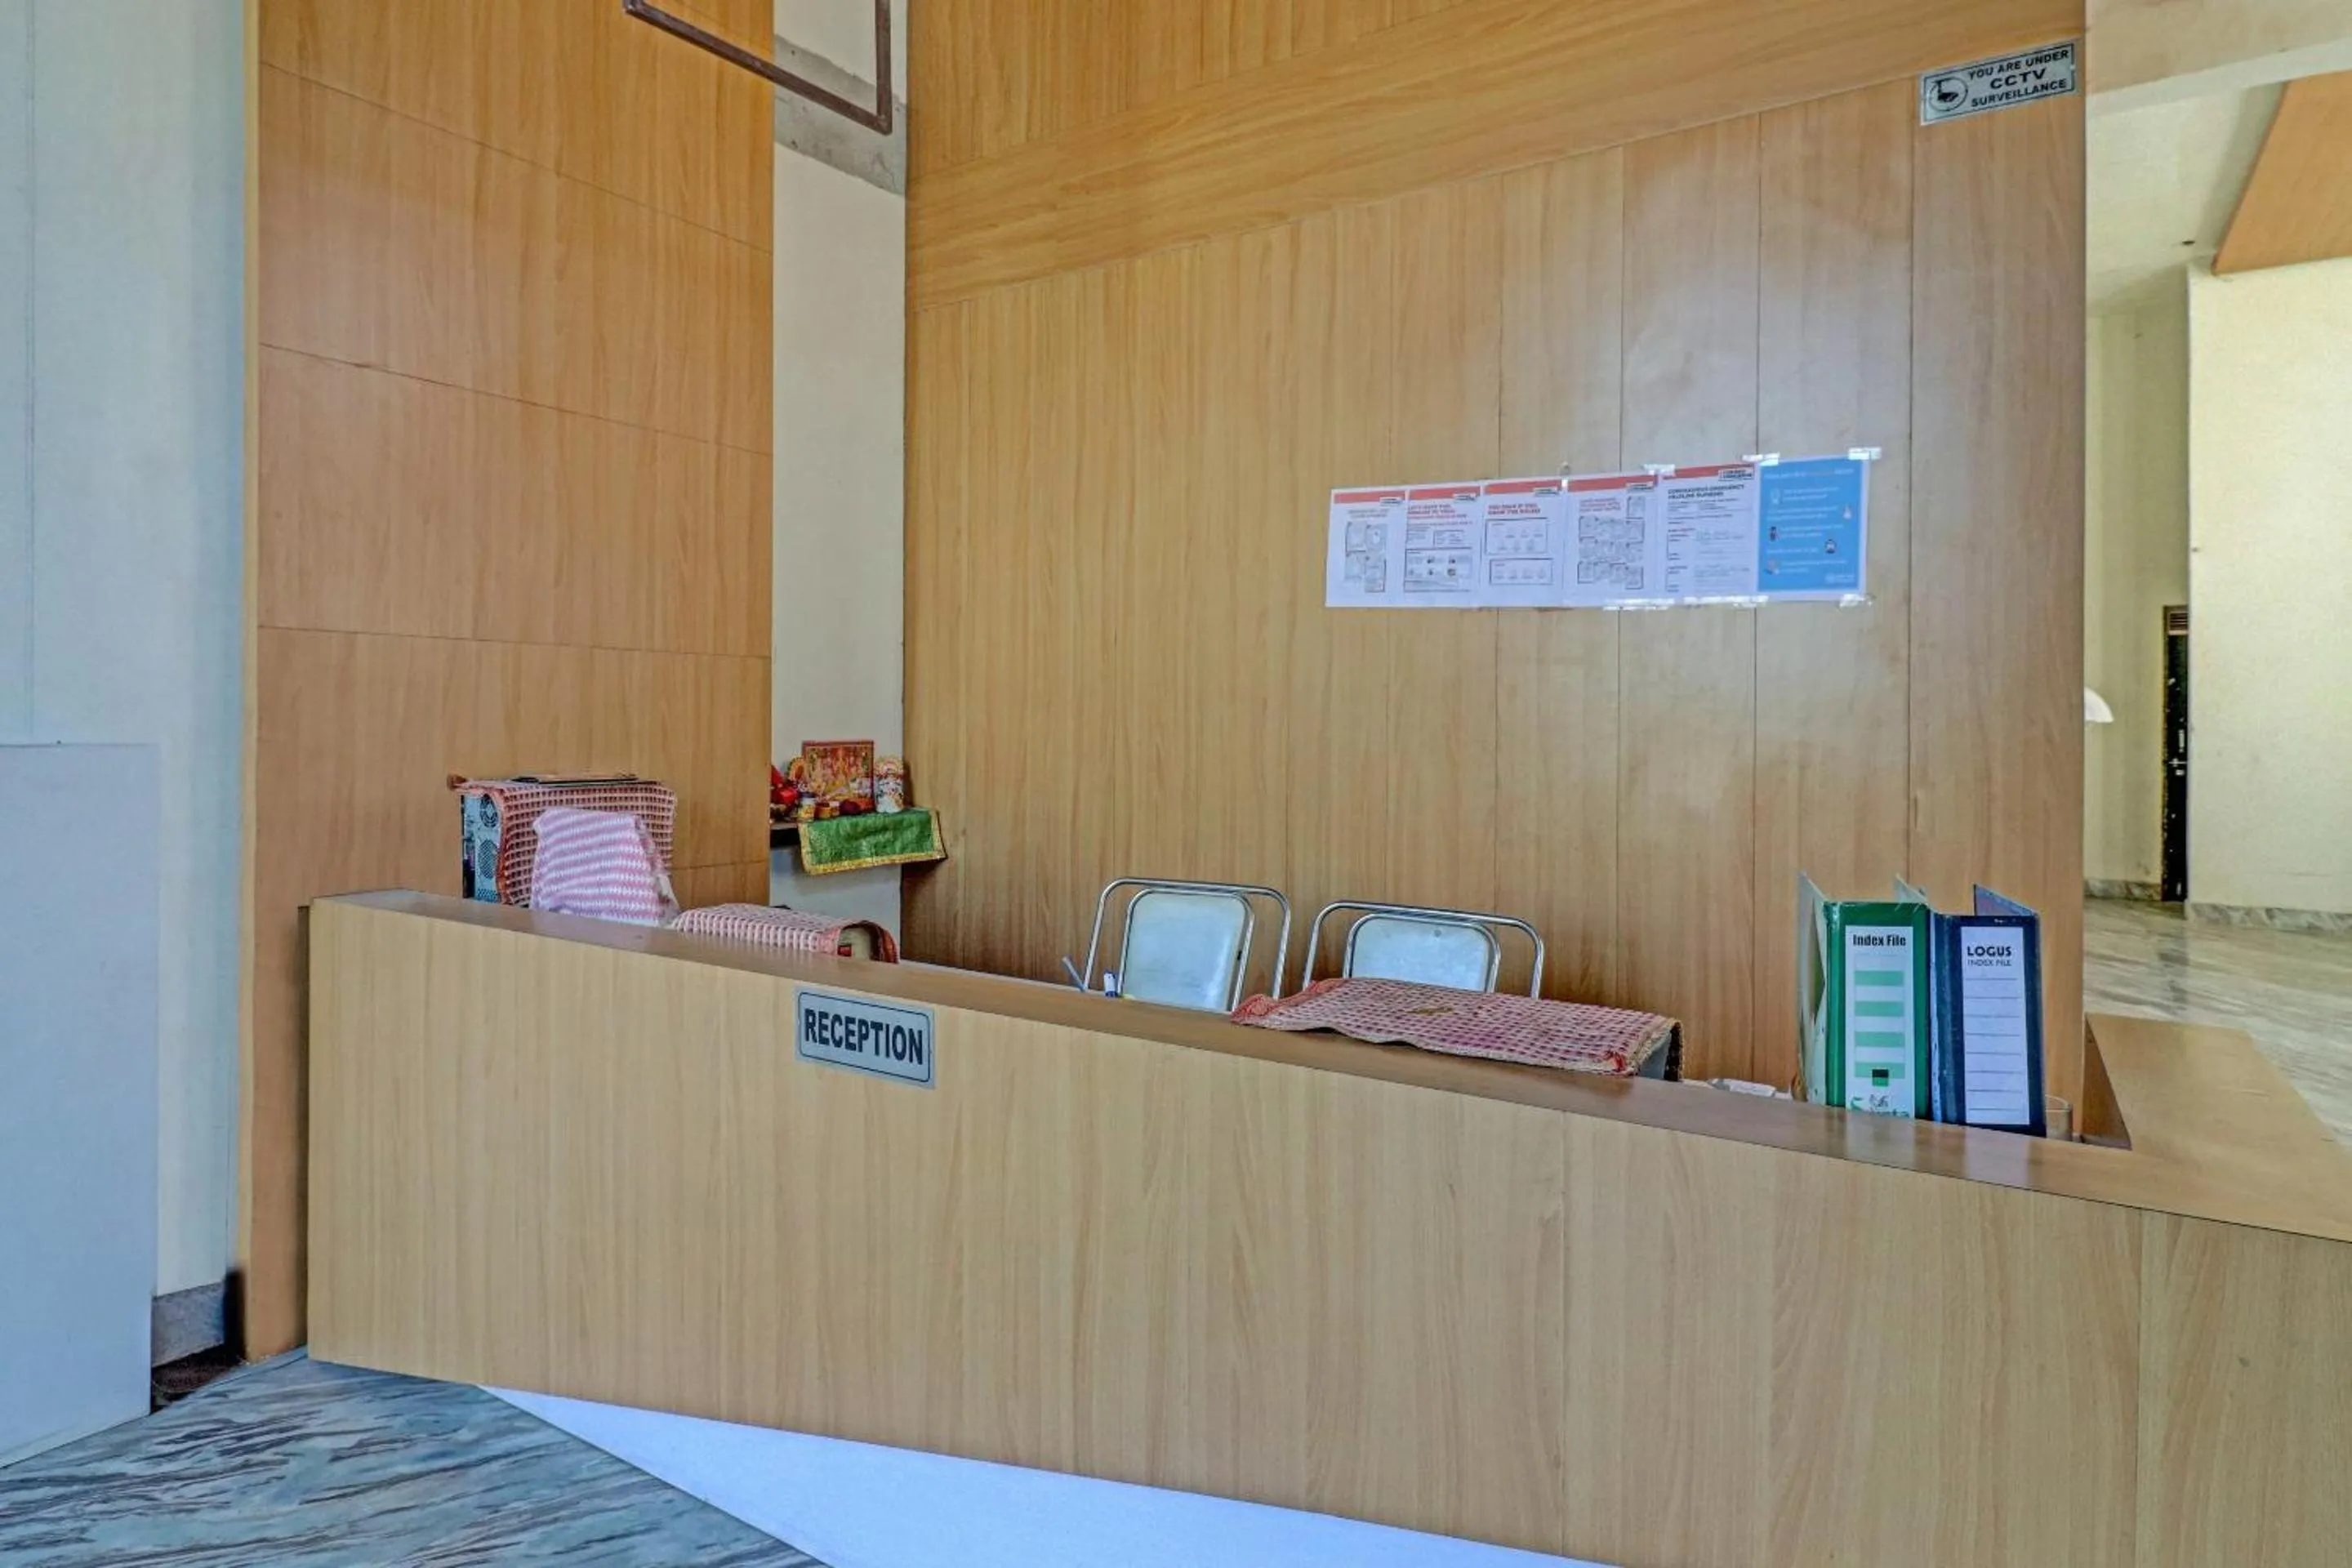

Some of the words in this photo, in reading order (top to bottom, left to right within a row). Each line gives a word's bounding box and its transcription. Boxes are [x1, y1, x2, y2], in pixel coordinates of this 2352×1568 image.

[1968, 66, 1993, 80] YOU
[1998, 60, 2021, 74] ARE
[2025, 49, 2069, 67] UNDER
[1990, 69, 2047, 89] CCTV
[1971, 78, 2067, 107] SURVEILLANCE
[1853, 934, 1884, 946] Index
[1886, 934, 1906, 946] File
[1967, 946, 2011, 956] LOGUS
[804, 1009, 923, 1065] RECEPTION
